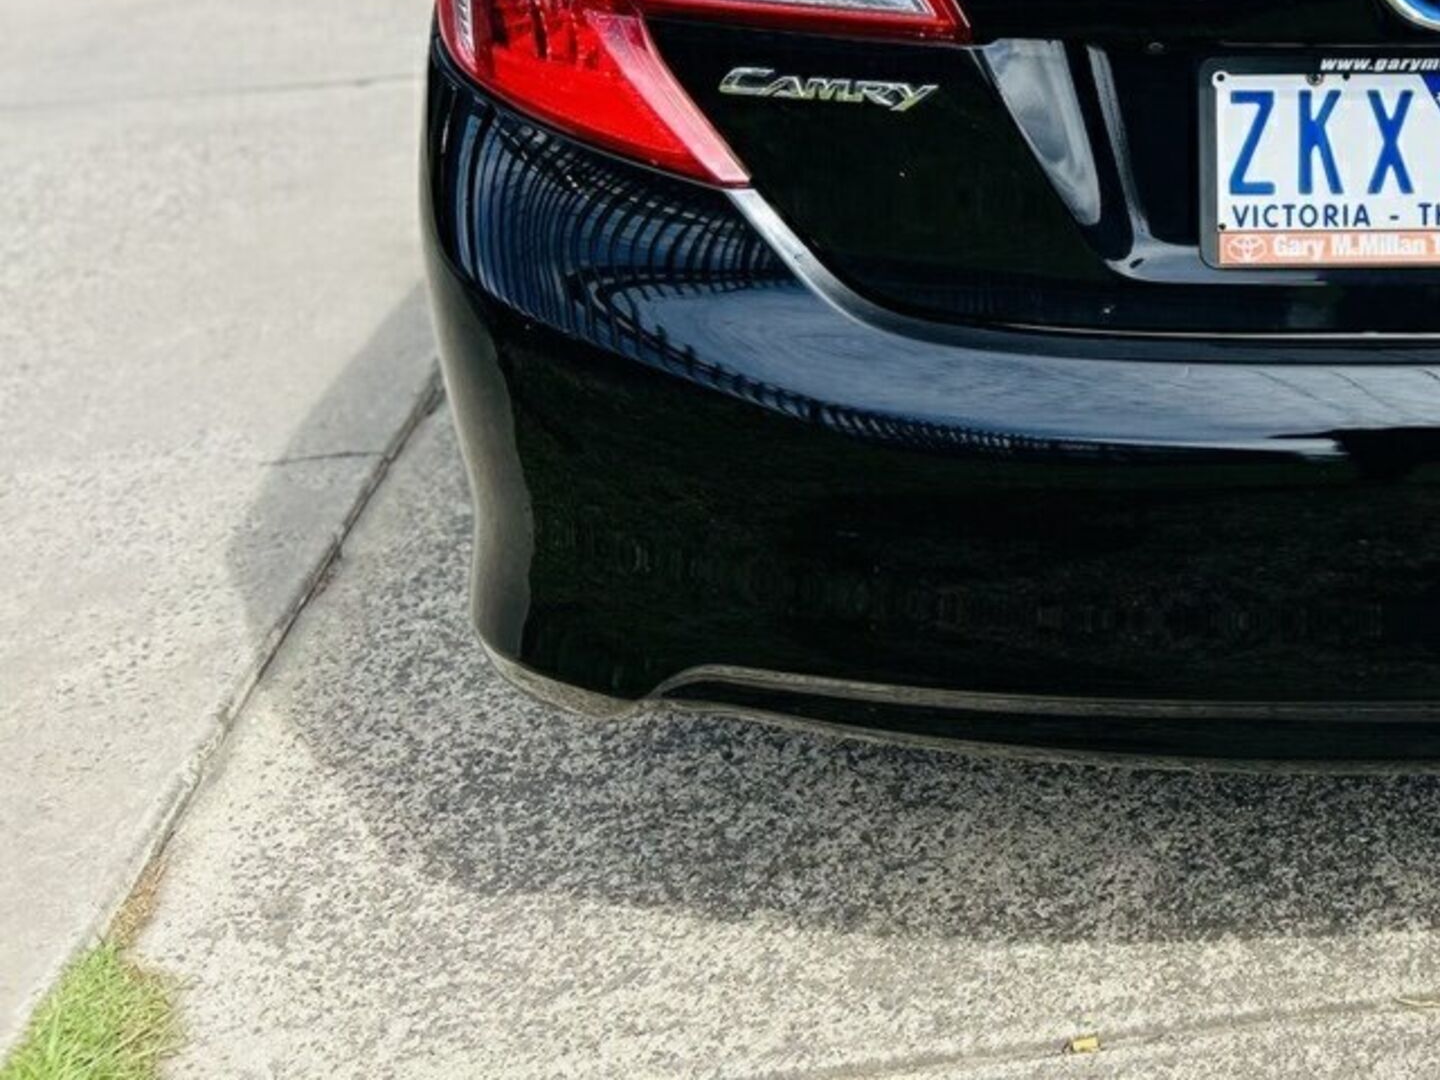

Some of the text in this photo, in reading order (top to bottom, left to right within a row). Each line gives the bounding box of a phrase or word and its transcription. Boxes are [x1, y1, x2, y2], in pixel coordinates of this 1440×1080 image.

[1228, 89, 1414, 195] ZKX
[1231, 203, 1371, 228] VICTORIA
[1273, 234, 1325, 259] Gary
